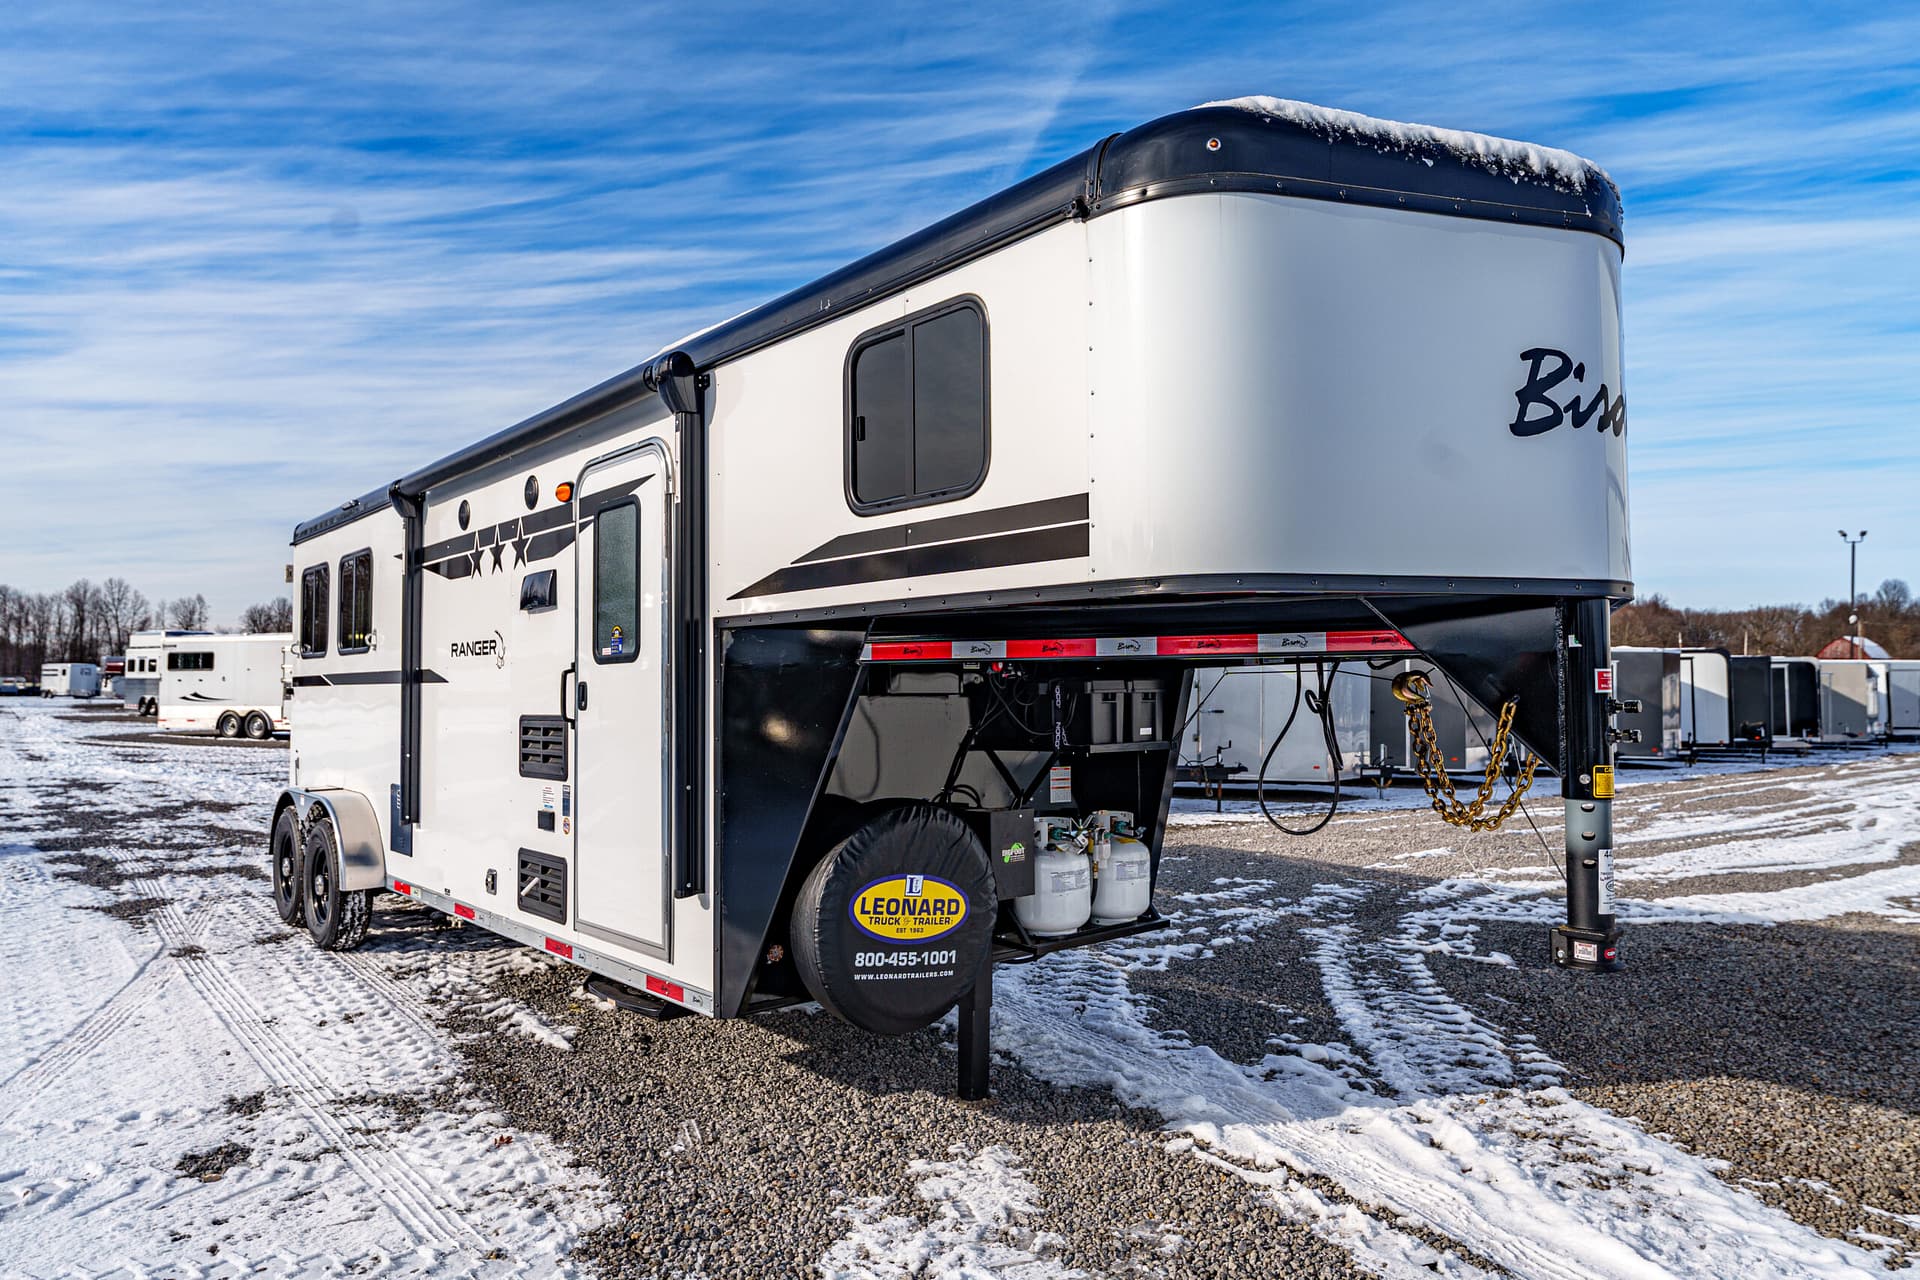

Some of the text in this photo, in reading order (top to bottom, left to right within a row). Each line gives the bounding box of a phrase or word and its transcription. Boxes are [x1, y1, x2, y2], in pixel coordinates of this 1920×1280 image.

[1509, 347, 1627, 438] Biso
[450, 639, 497, 658] RANGER
[860, 896, 961, 916] LEONARD
[868, 916, 901, 926] TRUCK
[913, 916, 950, 926] TRAILER
[854, 950, 957, 968] 800-455-1001
[853, 970, 954, 980] WWW.LEONARDTRAILERS.COM
